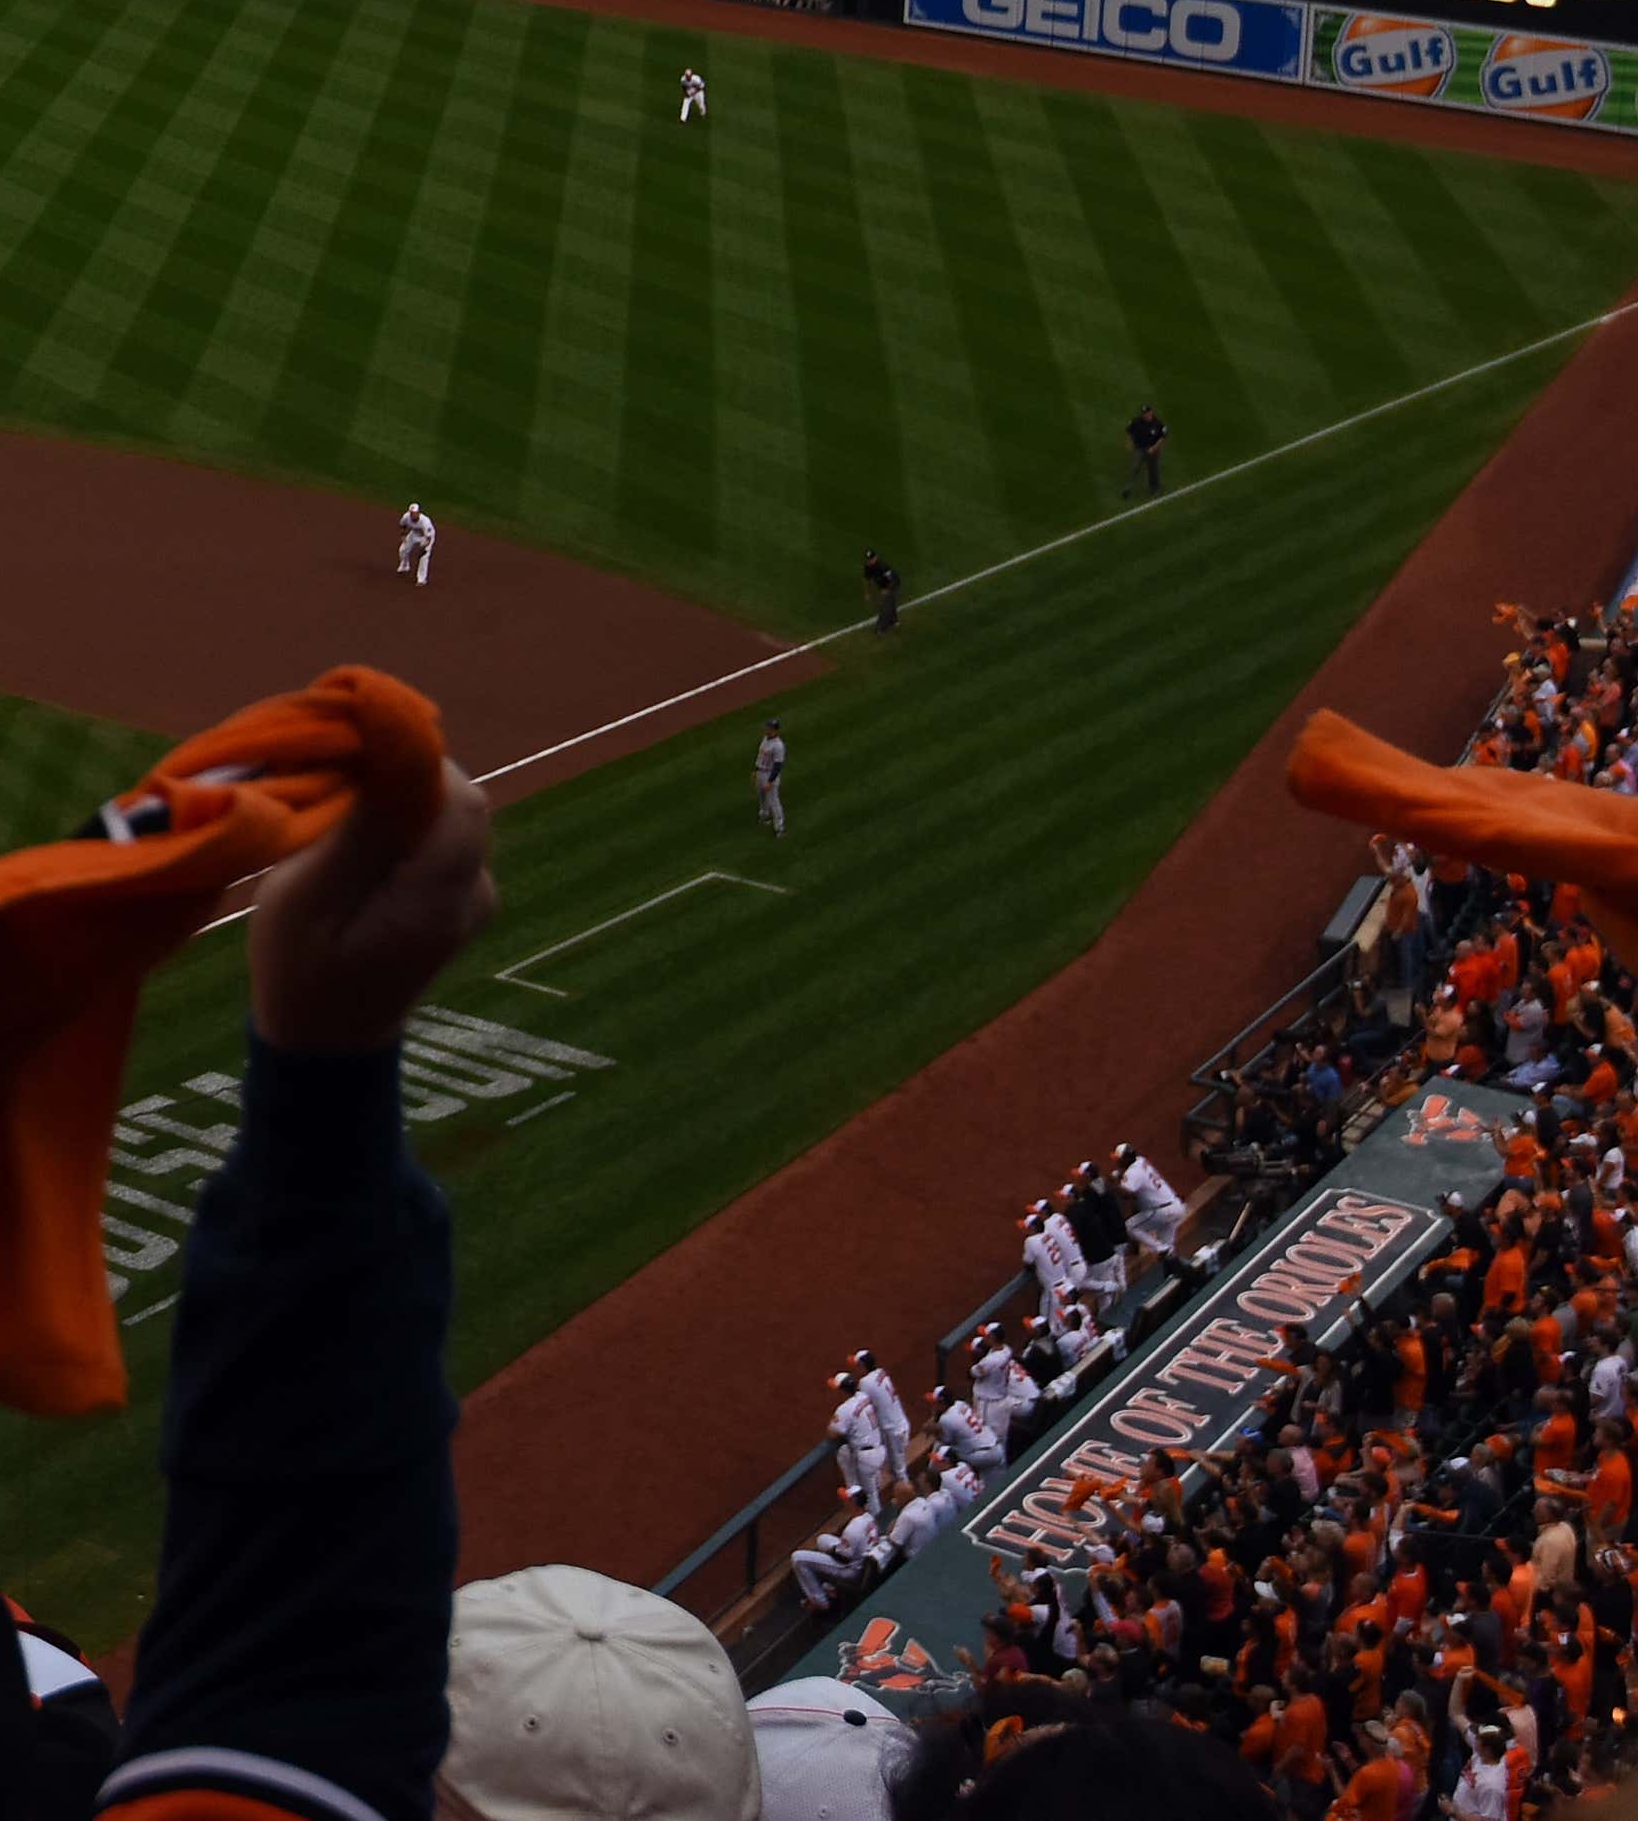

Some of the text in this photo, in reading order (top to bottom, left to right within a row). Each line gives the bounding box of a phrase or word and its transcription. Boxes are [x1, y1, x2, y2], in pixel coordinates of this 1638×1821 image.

[1341, 36, 1445, 80] Gulf
[1489, 57, 1599, 100] Gulf
[1236, 1195, 1414, 1323] ORIOLES
[1155, 1317, 1285, 1396] THE
[1109, 1387, 1213, 1446] OF
